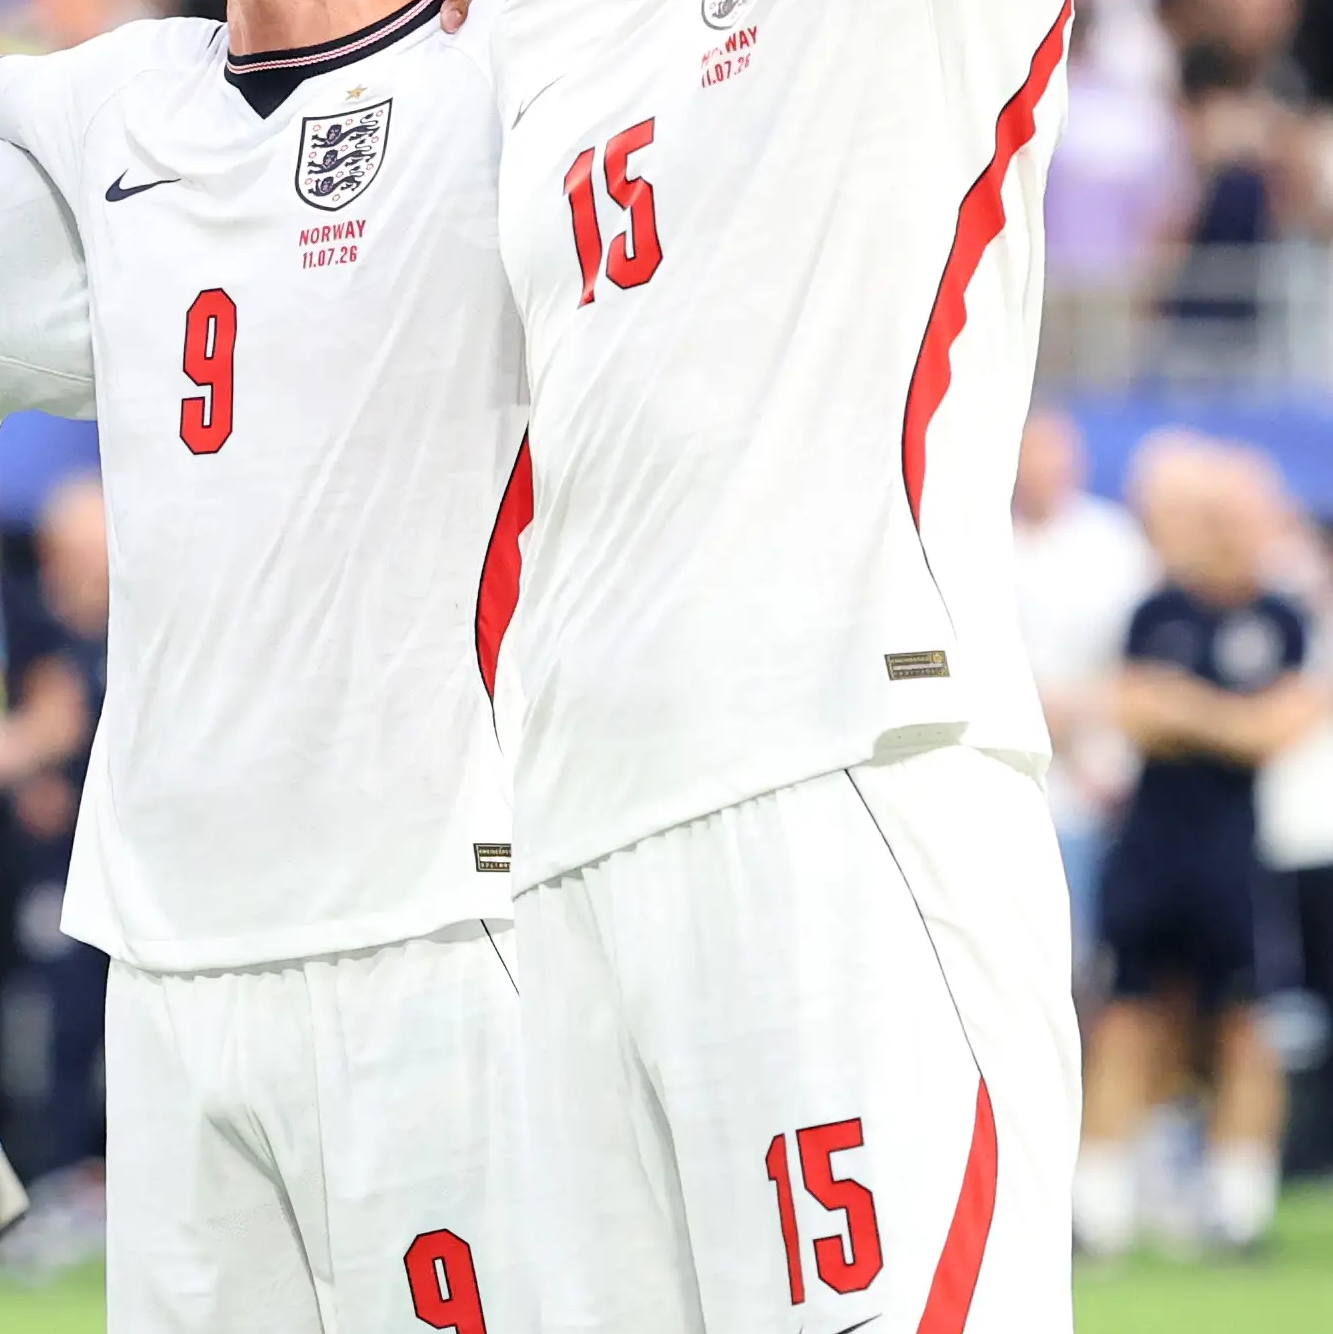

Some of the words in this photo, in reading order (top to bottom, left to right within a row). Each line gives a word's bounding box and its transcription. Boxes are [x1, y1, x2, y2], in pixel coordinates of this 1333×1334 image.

[701, 26, 757, 69] NWAY
[298, 219, 366, 247] NORWAY
[302, 245, 358, 269] 11.07.26
[563, 116, 664, 309] 15
[179, 287, 238, 455] 9
[765, 1117, 883, 1306] 15
